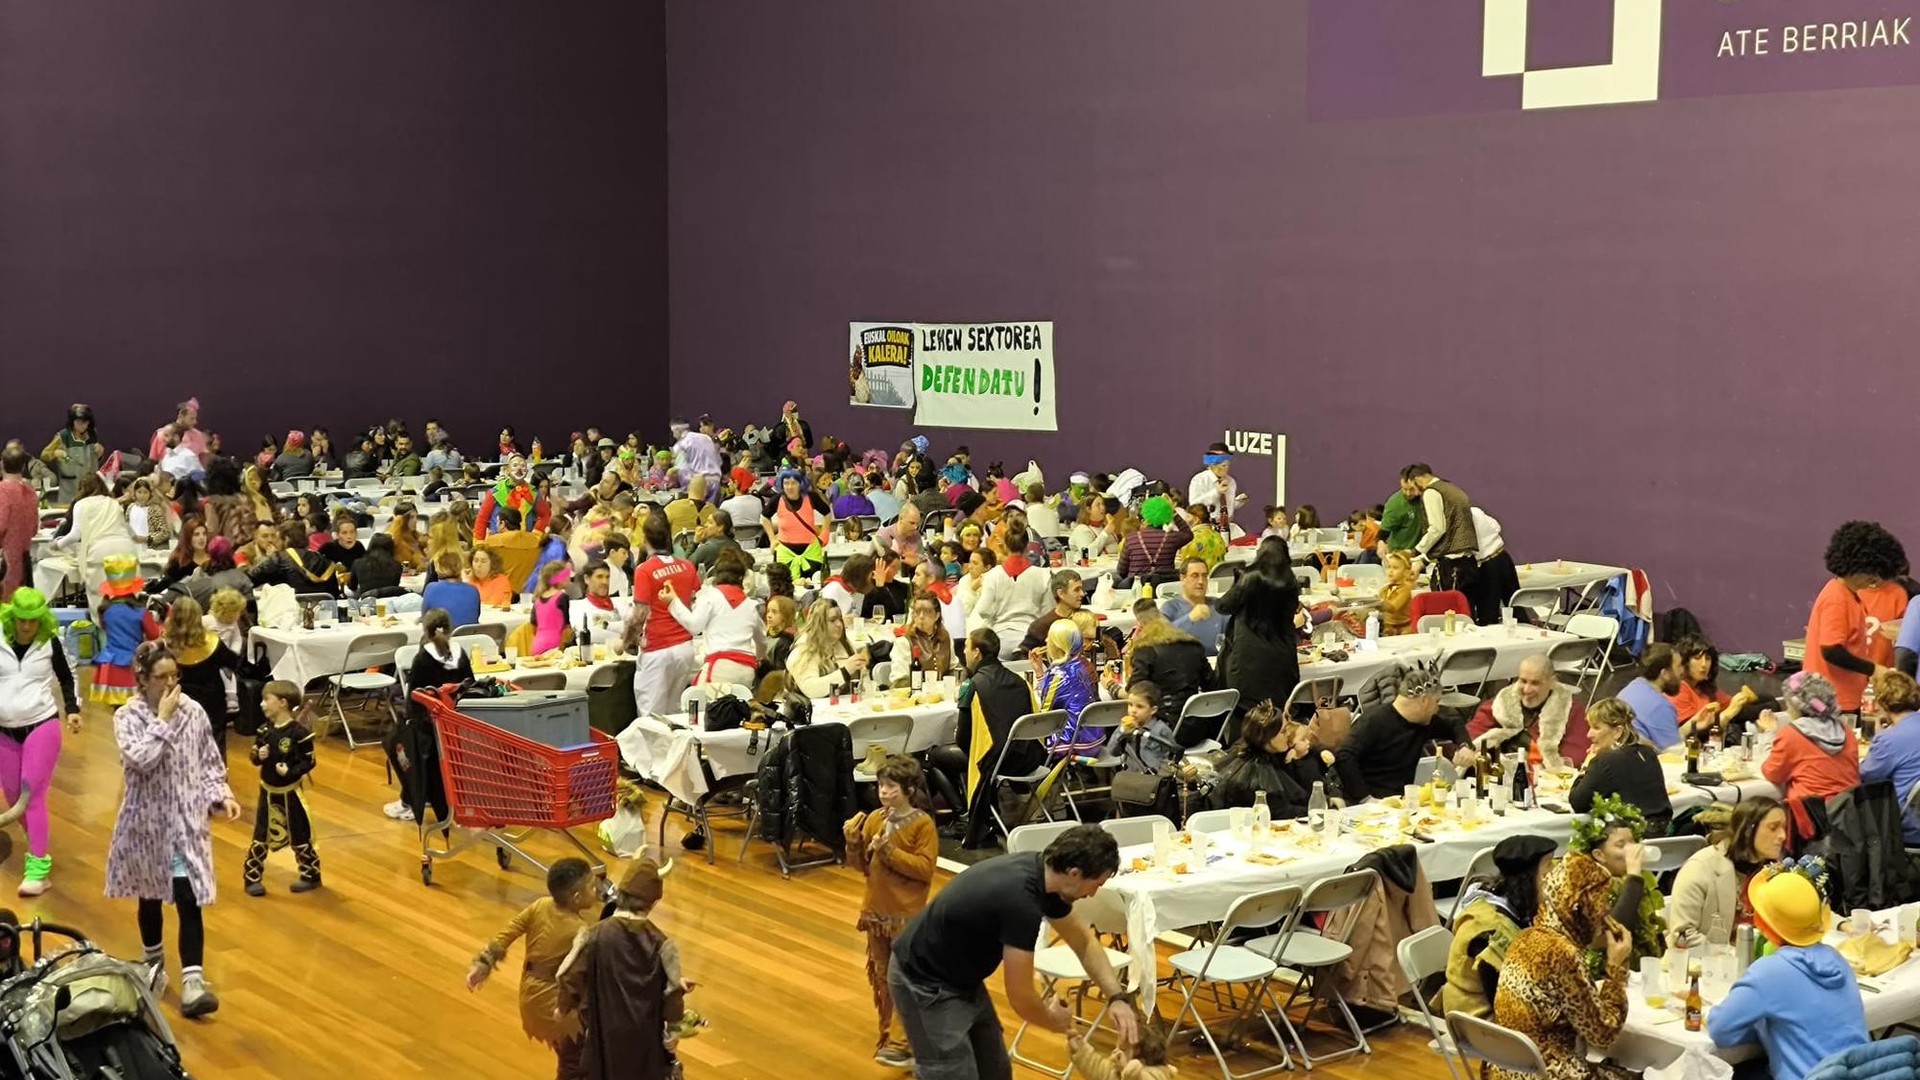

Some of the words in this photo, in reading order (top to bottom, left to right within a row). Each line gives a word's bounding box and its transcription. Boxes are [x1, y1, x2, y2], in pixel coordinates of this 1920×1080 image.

[1717, 28, 1769, 58] ATE
[1783, 17, 1911, 53] BERRIAK
[864, 330, 886, 345] EUSKAL
[922, 328, 962, 352] LEHEN
[967, 324, 1042, 351] SEKTOREA
[868, 344, 908, 365] KALERA!
[922, 364, 1025, 397] DEFENDATU
[1225, 430, 1272, 454] LUZE
